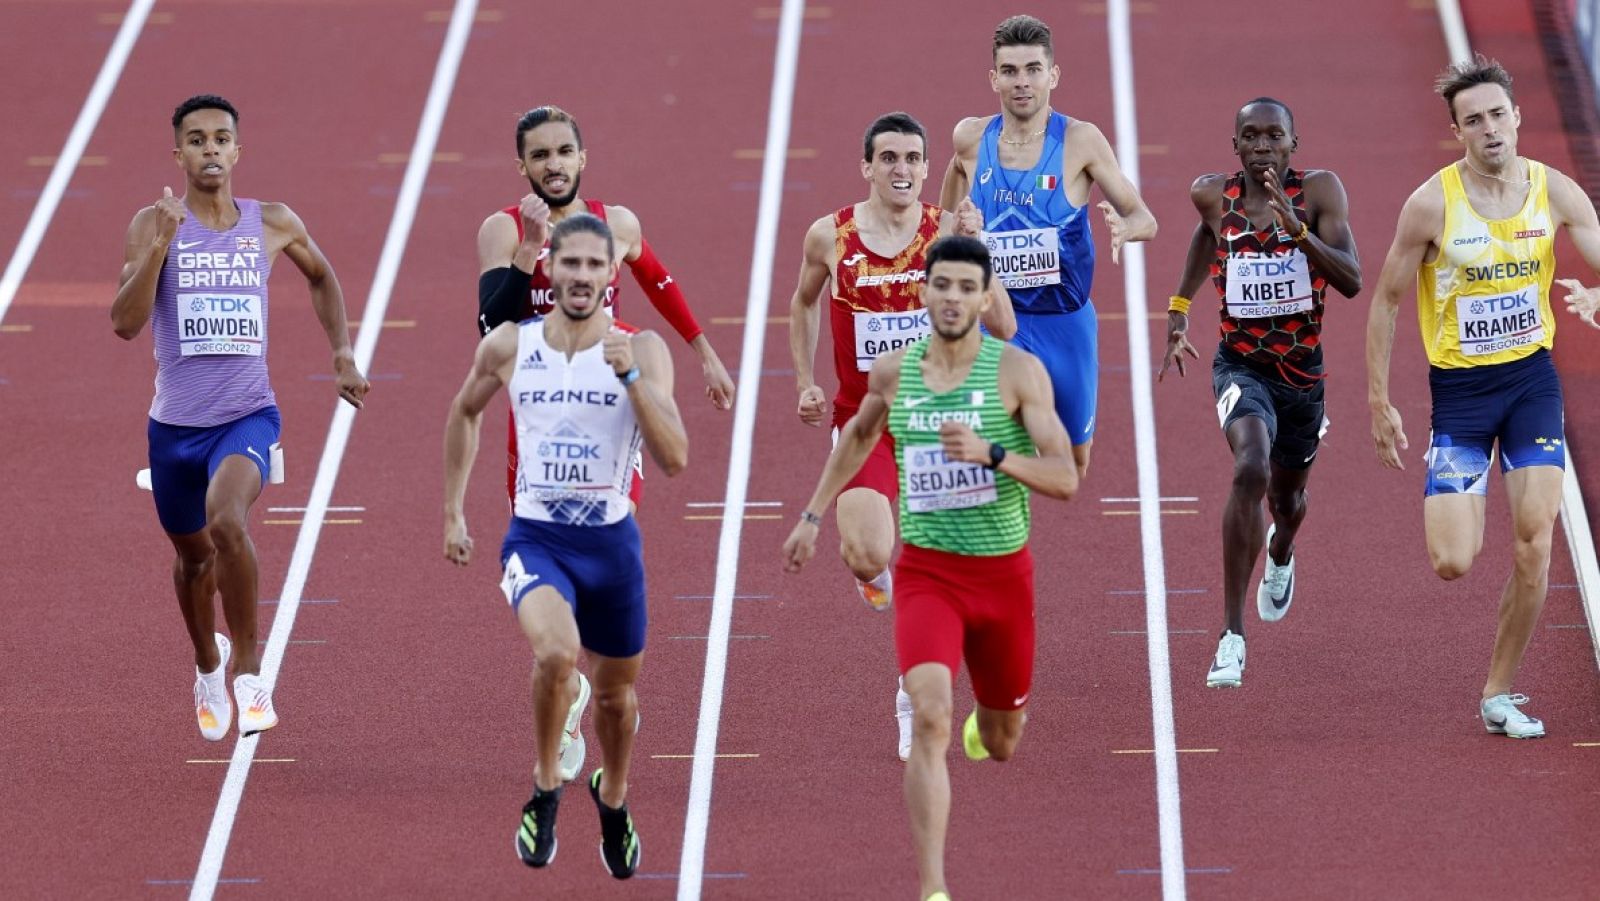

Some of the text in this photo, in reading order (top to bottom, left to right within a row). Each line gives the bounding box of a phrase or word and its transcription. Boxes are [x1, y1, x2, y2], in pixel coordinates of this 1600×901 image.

[994, 189, 1033, 206] ITALIA
[997, 233, 1044, 249] TDK
[178, 252, 259, 269] GREAT
[989, 252, 1055, 274] CUCEANU
[1250, 259, 1296, 276] TDK
[178, 270, 260, 288] BRITAIN
[1465, 260, 1540, 282] SWEDEN
[1003, 277, 1047, 288] EGON22
[1242, 280, 1295, 301] KIBET
[206, 298, 251, 313] TDK
[1240, 303, 1300, 316] OREGON22
[1484, 291, 1529, 313] TDK
[184, 318, 258, 337] ROWDEN
[881, 315, 929, 331] TDK
[1464, 309, 1536, 339] KRAMER
[194, 343, 251, 353] OREGON22
[1475, 336, 1532, 354] OREGON22
[520, 390, 619, 406] FRANCE
[550, 442, 600, 459] TDK
[543, 462, 593, 482] TUAL
[910, 467, 989, 492] SEDJATI
